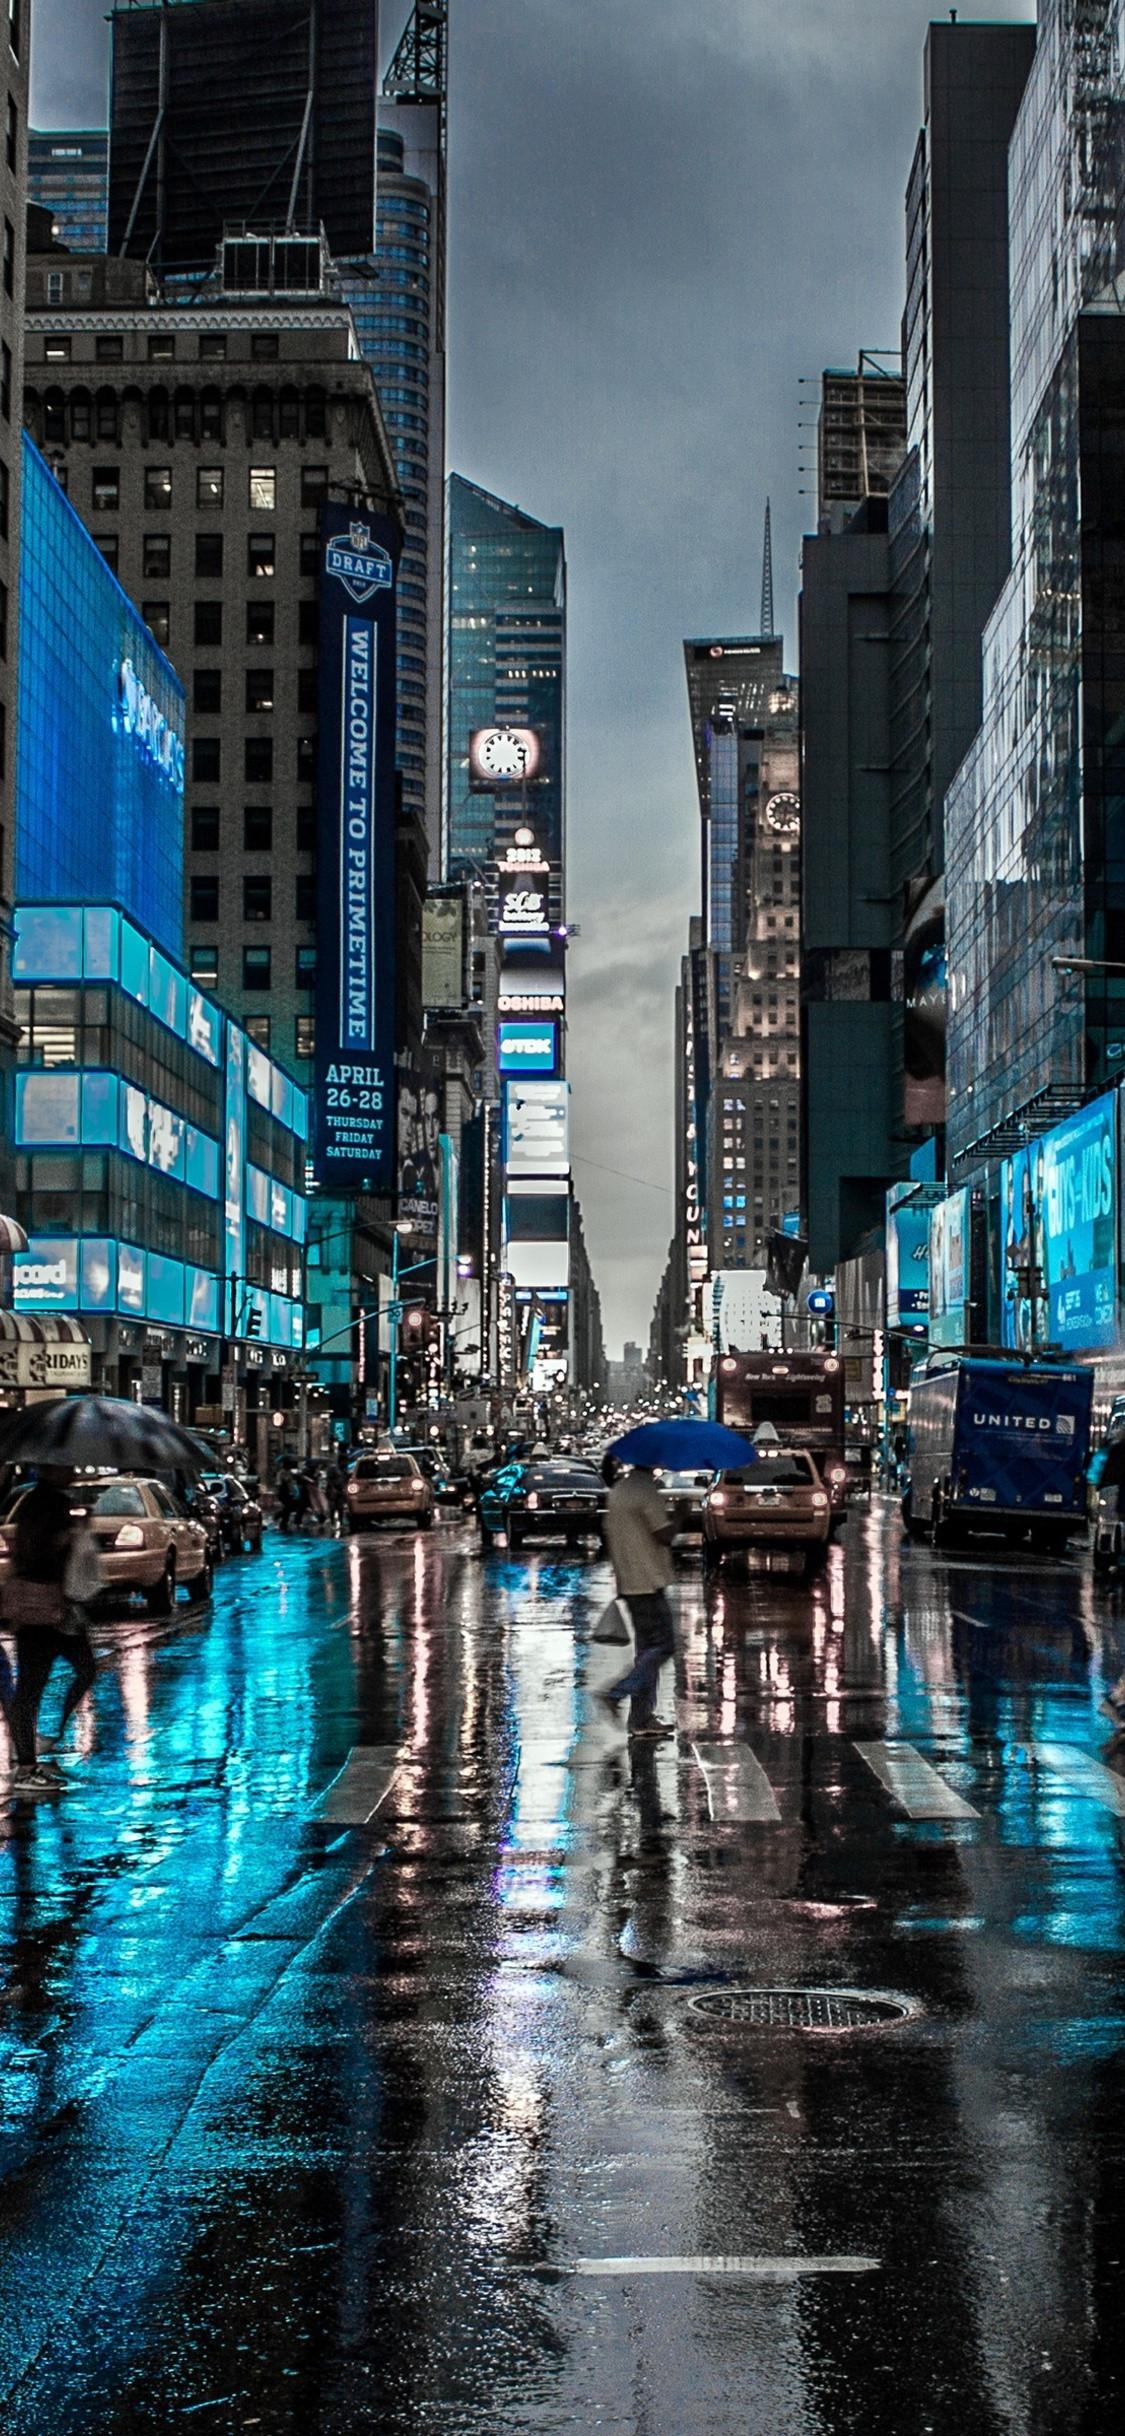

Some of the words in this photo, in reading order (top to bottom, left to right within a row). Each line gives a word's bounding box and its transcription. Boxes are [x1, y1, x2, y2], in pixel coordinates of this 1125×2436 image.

[332, 553, 386, 578] DRAFT
[349, 630, 369, 789] WELCOME
[348, 797, 367, 840] TO
[348, 848, 367, 1039] PRIMETIME
[325, 1064, 384, 1087] APRIL
[326, 1088, 383, 1110] 26-28
[326, 1115, 383, 1130] THURSDAY
[335, 1132, 374, 1144] FRIDAY
[326, 1146, 382, 1160] SATURDAY
[973, 1413, 1051, 1429] UNITED
